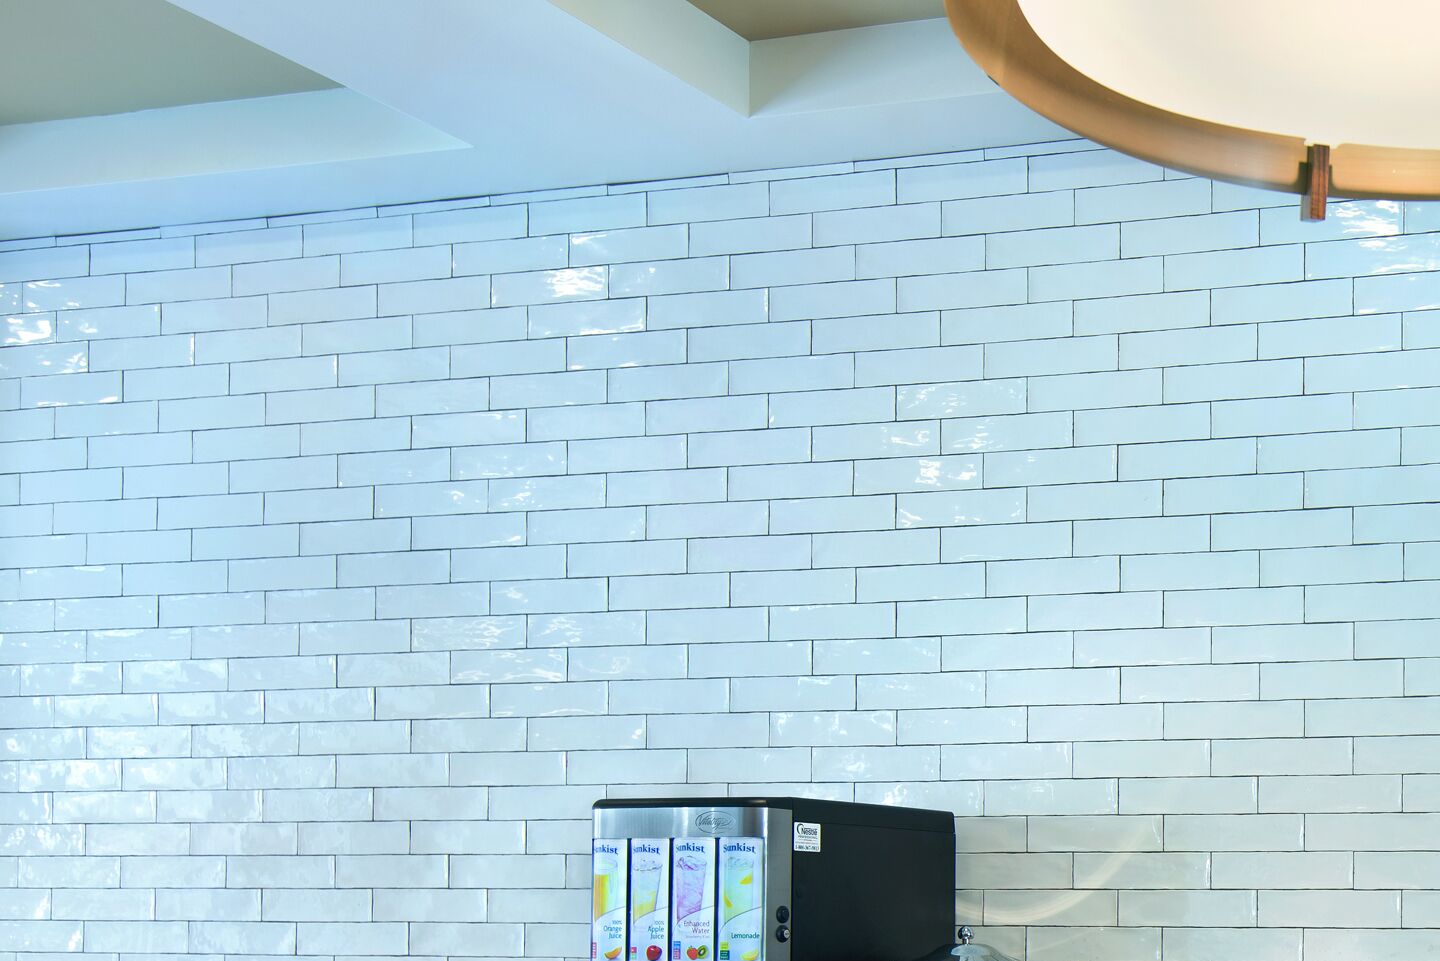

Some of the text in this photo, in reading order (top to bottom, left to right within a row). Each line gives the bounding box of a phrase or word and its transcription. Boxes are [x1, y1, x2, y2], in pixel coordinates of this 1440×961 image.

[675, 842, 705, 854] Sunkist
[722, 842, 756, 854] Sunkist
[603, 925, 622, 933] Orange
[648, 925, 664, 933] Apple
